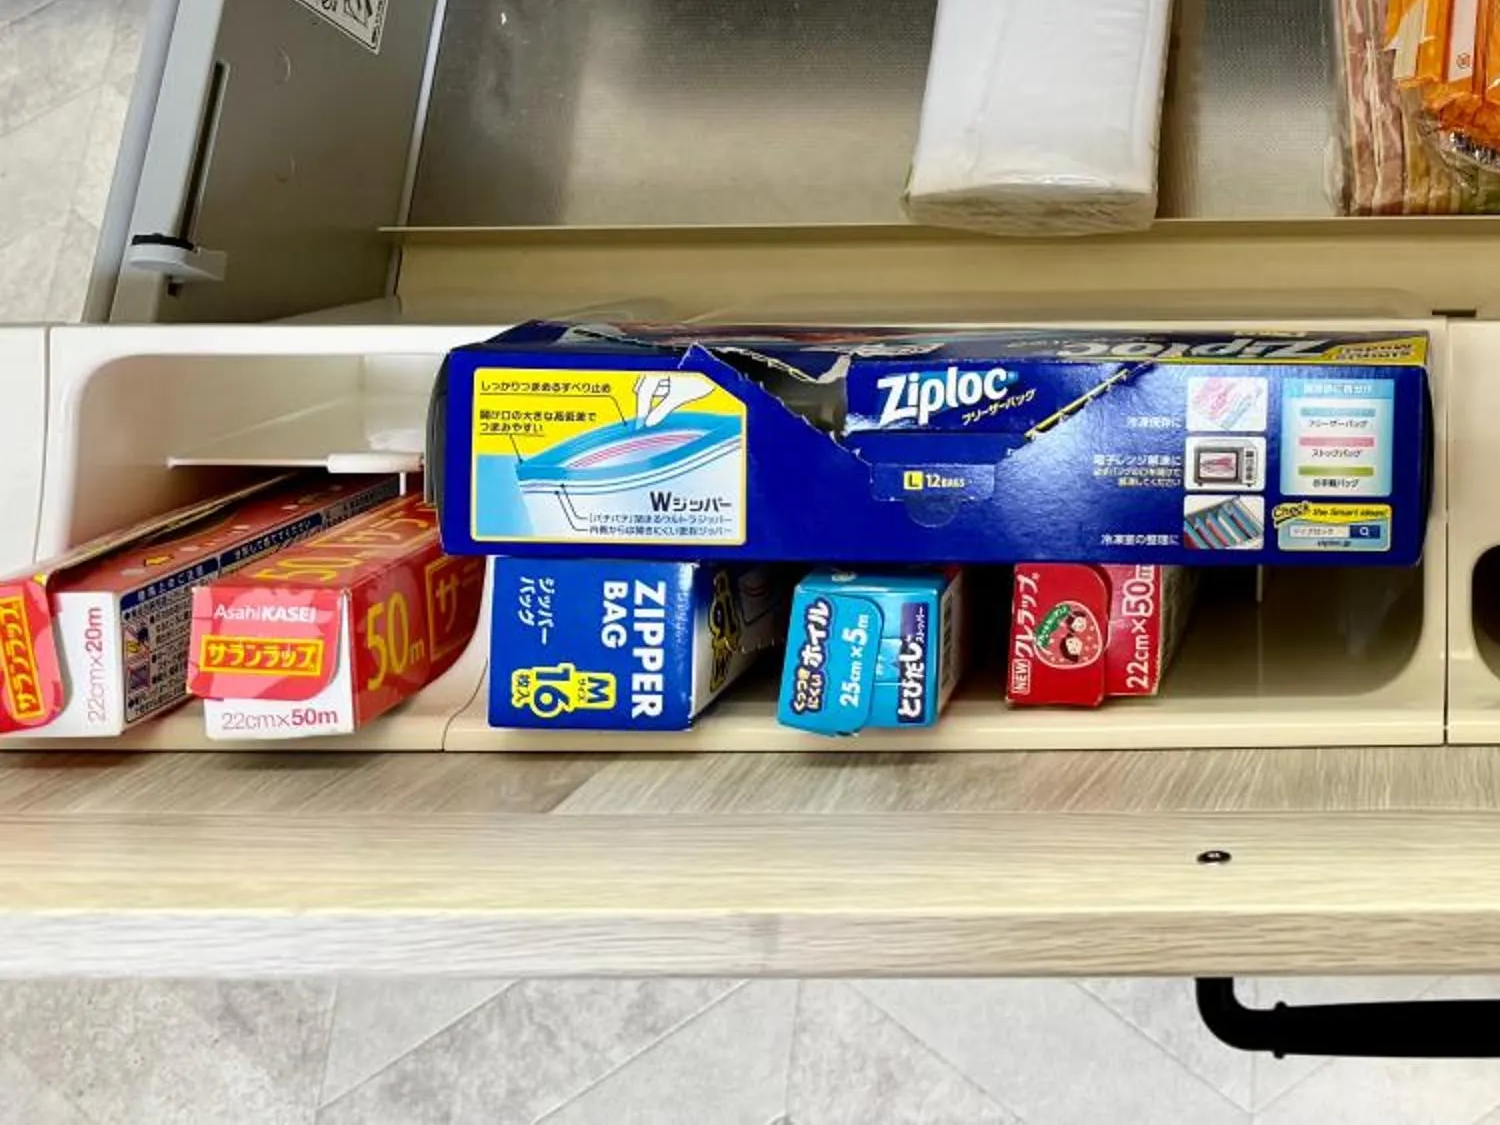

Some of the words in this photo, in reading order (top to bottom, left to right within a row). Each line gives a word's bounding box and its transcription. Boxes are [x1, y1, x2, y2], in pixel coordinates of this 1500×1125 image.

[877, 367, 1008, 426] Ziploc
[961, 389, 1035, 425] フリーザーバッグ
[517, 577, 535, 627] バッグ
[538, 577, 555, 645] ジッパー
[601, 581, 629, 649] BAG
[1014, 574, 1037, 659] クレラップ
[207, 643, 318, 670] サランラップ
[631, 579, 666, 718] ZIPPER
[802, 602, 829, 668] ホイル
[534, 668, 570, 713] 16
[1014, 662, 1028, 691] NEW
